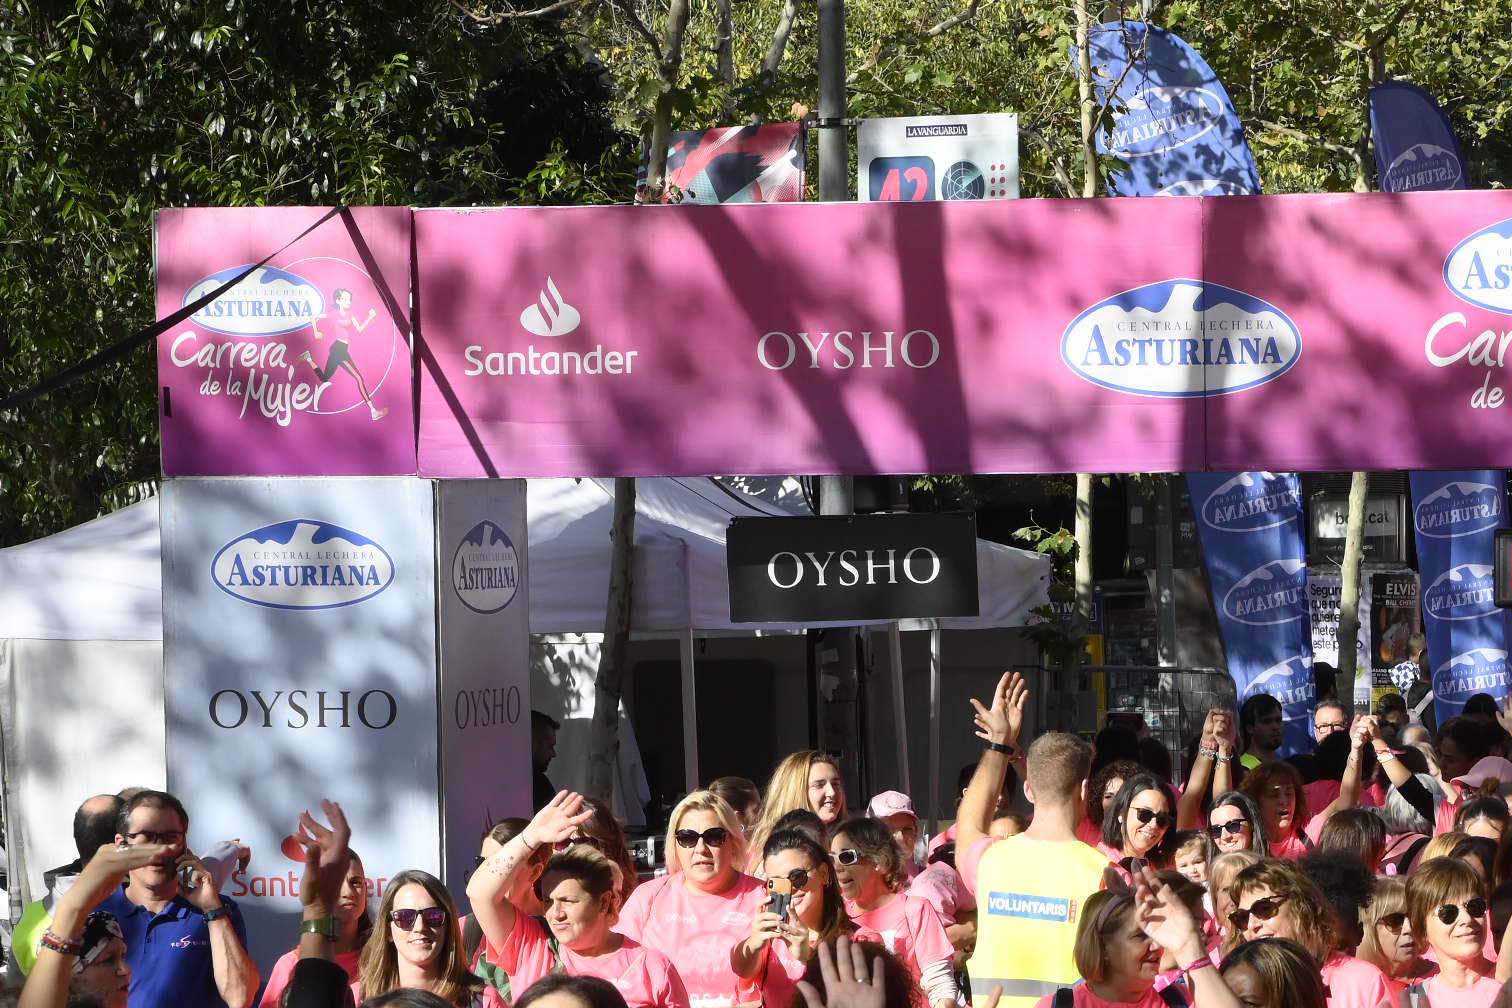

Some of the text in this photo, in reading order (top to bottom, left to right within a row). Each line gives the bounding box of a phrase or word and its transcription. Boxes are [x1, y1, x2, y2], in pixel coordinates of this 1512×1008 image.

[907, 125, 967, 137] LA VANGUARDIA
[196, 291, 313, 318] ASTURIANA
[1117, 318, 1275, 332] CENTRAL LECHERA
[170, 330, 287, 369] Carrera
[464, 345, 638, 376] Santander
[756, 329, 940, 370] OYSHO
[1080, 323, 1282, 367] ASTURIANA
[200, 366, 332, 427] de la Mujer
[1470, 371, 1505, 409] de
[226, 553, 382, 587] ASTURIANA
[253, 551, 375, 560] CENTRAL LECHERA
[766, 546, 941, 589] OYSHO
[458, 556, 516, 592] ASTURIANA
[1386, 583, 1416, 596] ELVIS
[1311, 600, 1327, 611] que
[1312, 639, 1331, 649] este
[208, 689, 398, 729] OYSHO
[454, 685, 521, 731] OYSHO
[231, 870, 391, 897] Santer
[990, 896, 1066, 917] VOLUNTARIS
